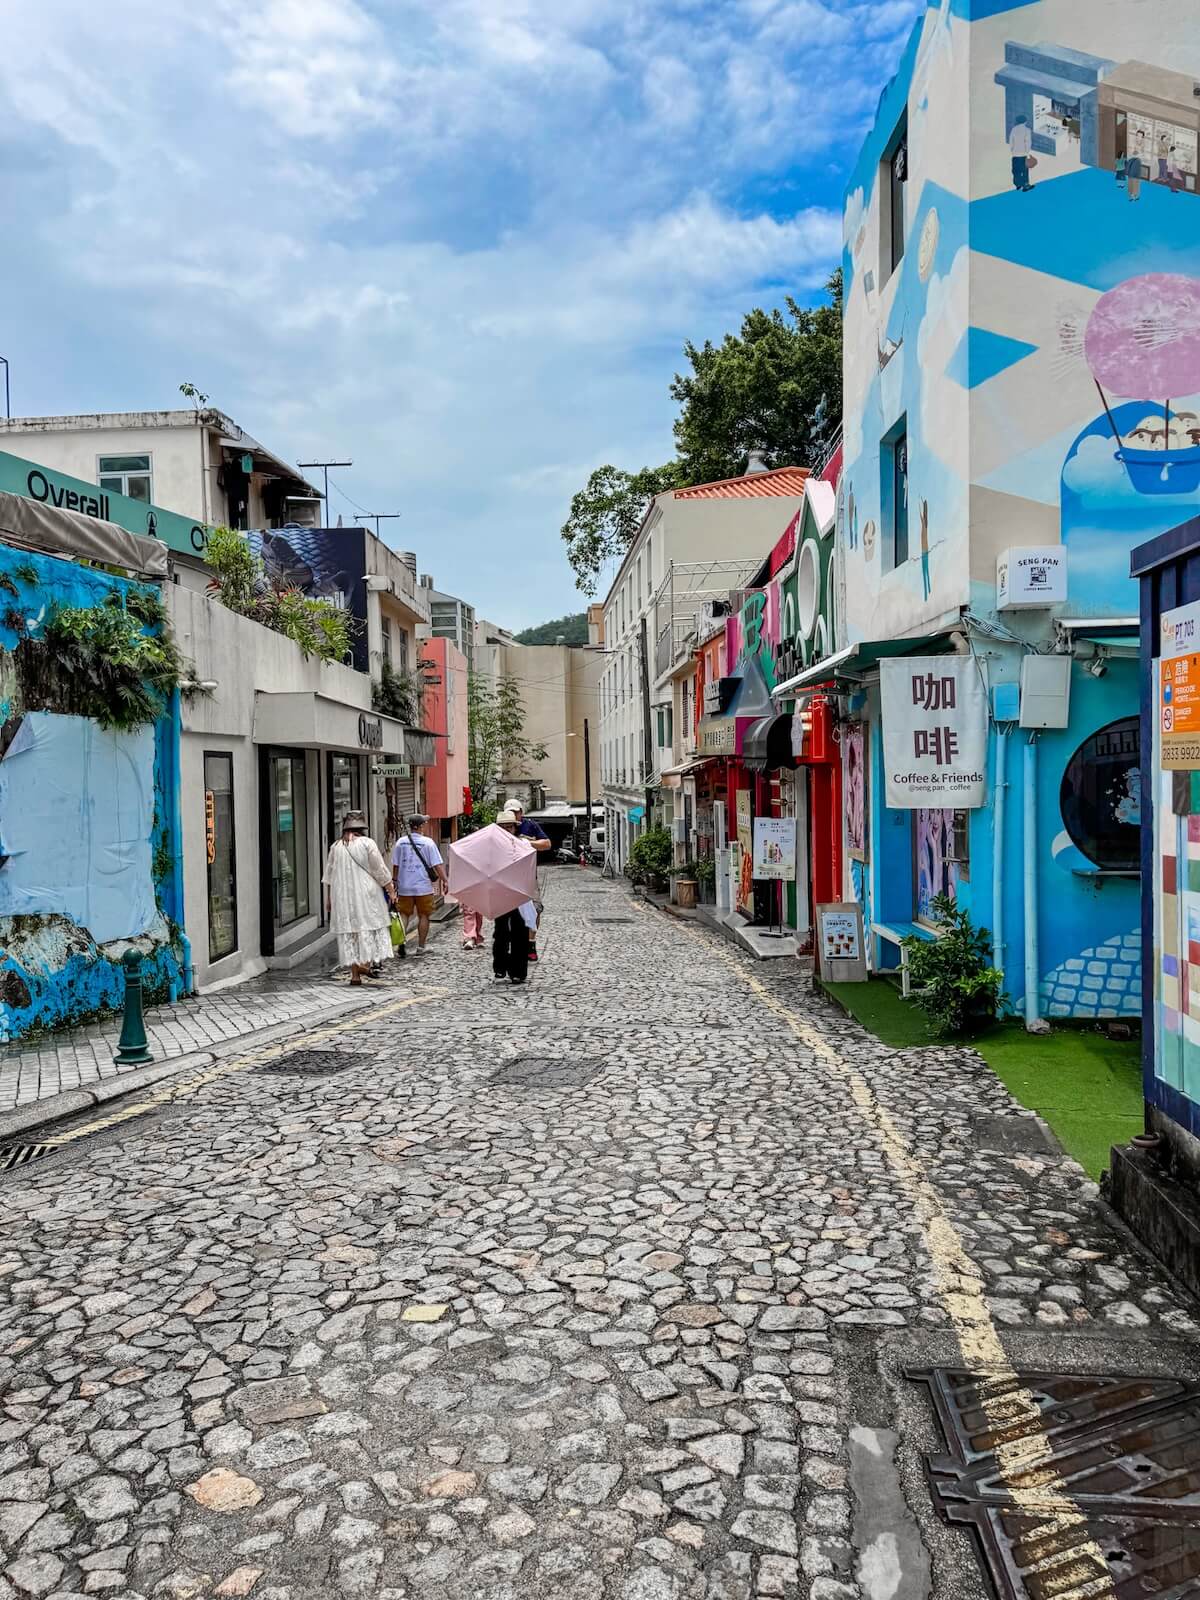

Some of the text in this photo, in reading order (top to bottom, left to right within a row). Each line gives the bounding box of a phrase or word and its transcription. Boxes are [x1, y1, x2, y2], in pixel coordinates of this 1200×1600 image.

[27, 470, 110, 522] Overall
[1017, 557, 1059, 567] SENG PAN
[911, 672, 959, 765] 咖啡
[1162, 746, 1200, 761] 2833 9922
[375, 766, 405, 776] Overall
[893, 771, 984, 784] Coffee & Friends
